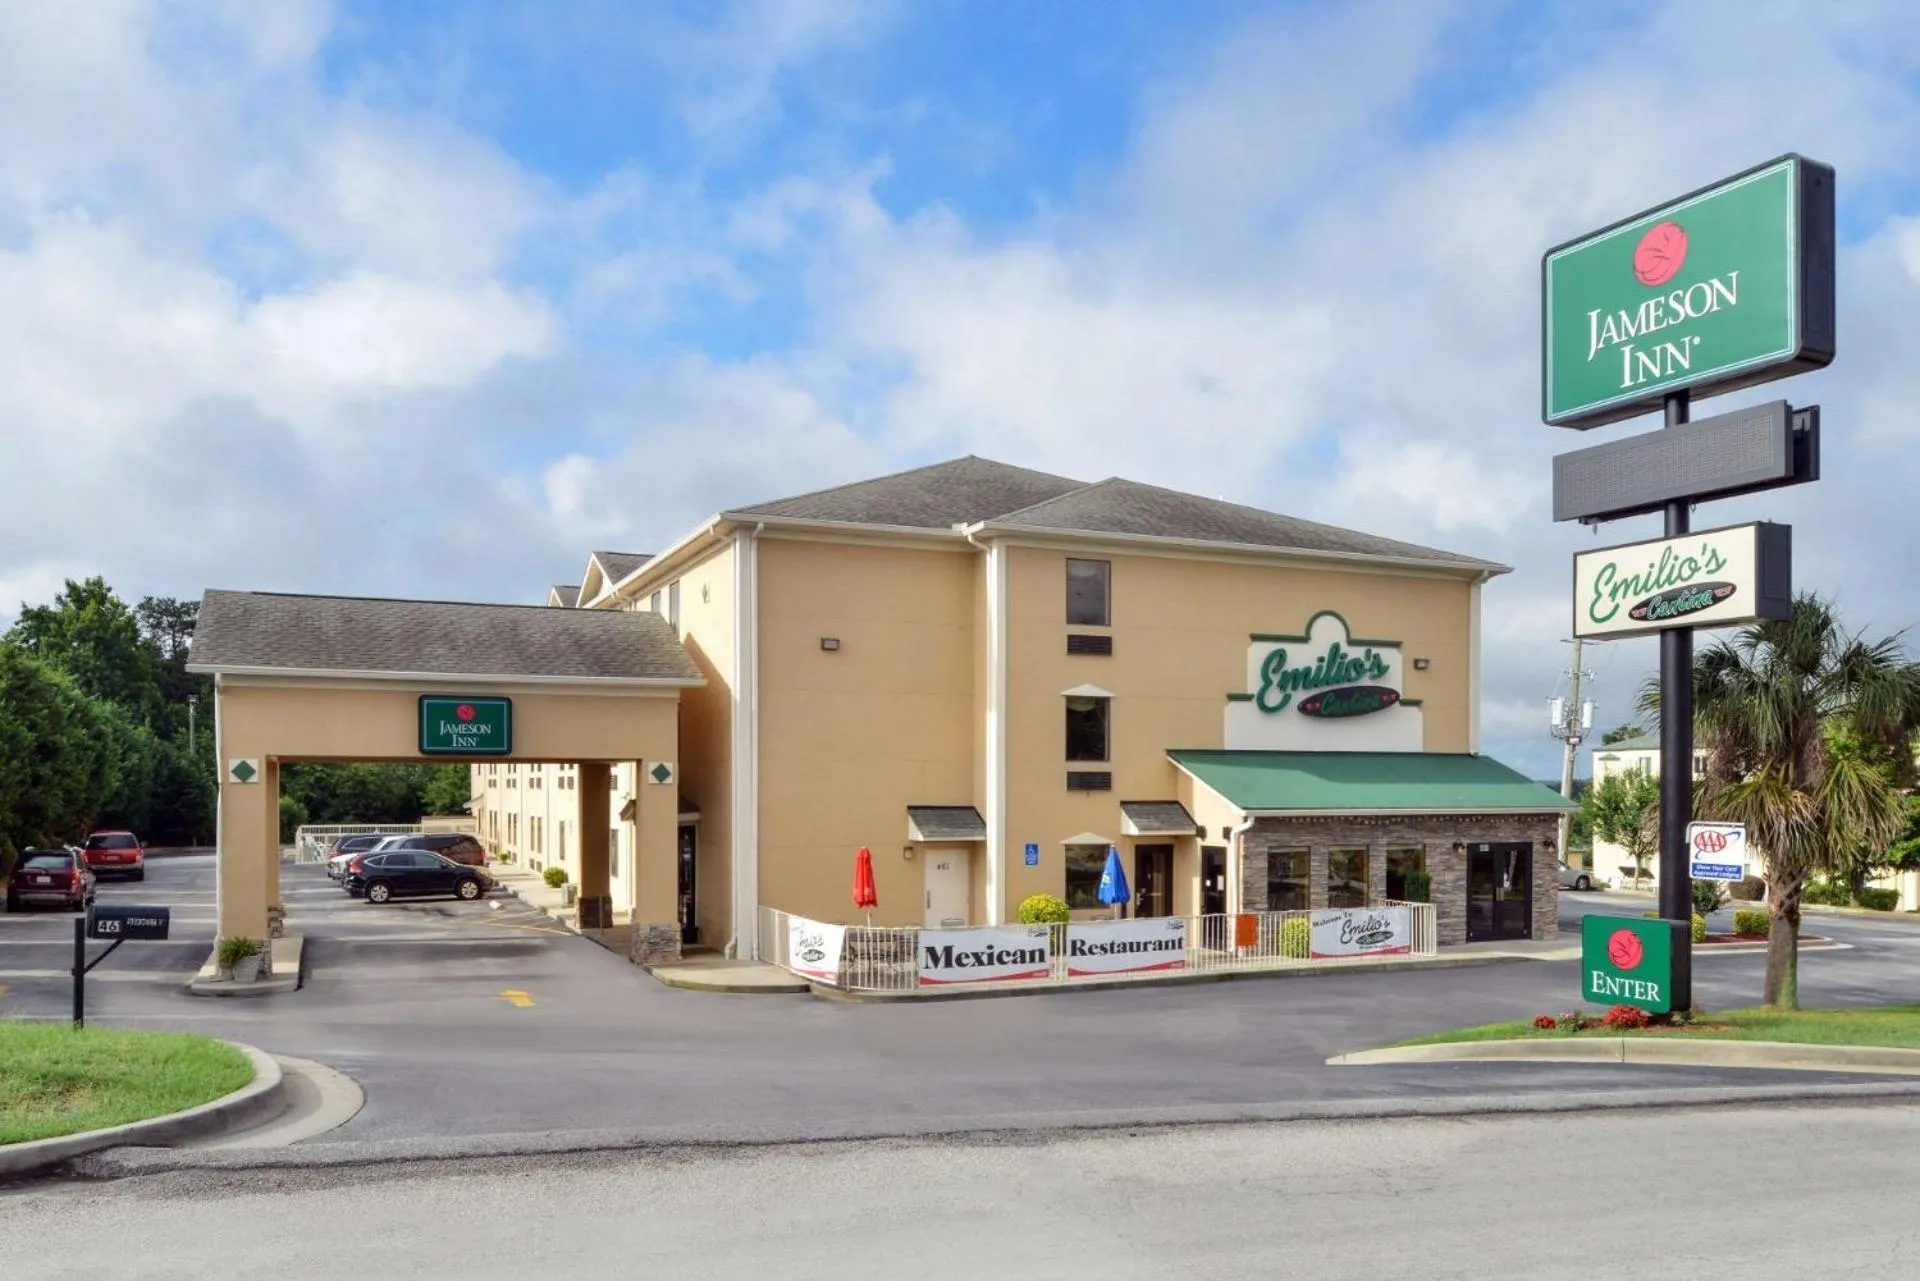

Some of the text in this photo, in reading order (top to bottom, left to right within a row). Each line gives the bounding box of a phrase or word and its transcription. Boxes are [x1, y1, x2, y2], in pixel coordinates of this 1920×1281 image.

[1587, 270, 1740, 361] JAMESON
[1620, 335, 1694, 388] INN
[1589, 542, 1727, 624] Emilio's
[1646, 587, 1713, 619] Cantina
[1256, 642, 1390, 714] Emilio's
[440, 720, 491, 735] JAMESON
[452, 734, 477, 747] INN
[99, 920, 119, 932] 46
[1340, 914, 1391, 944] Emilio's
[923, 944, 1046, 970] Mexican
[1070, 937, 1184, 957] Restaurant
[1591, 970, 1661, 1002] ENTER
